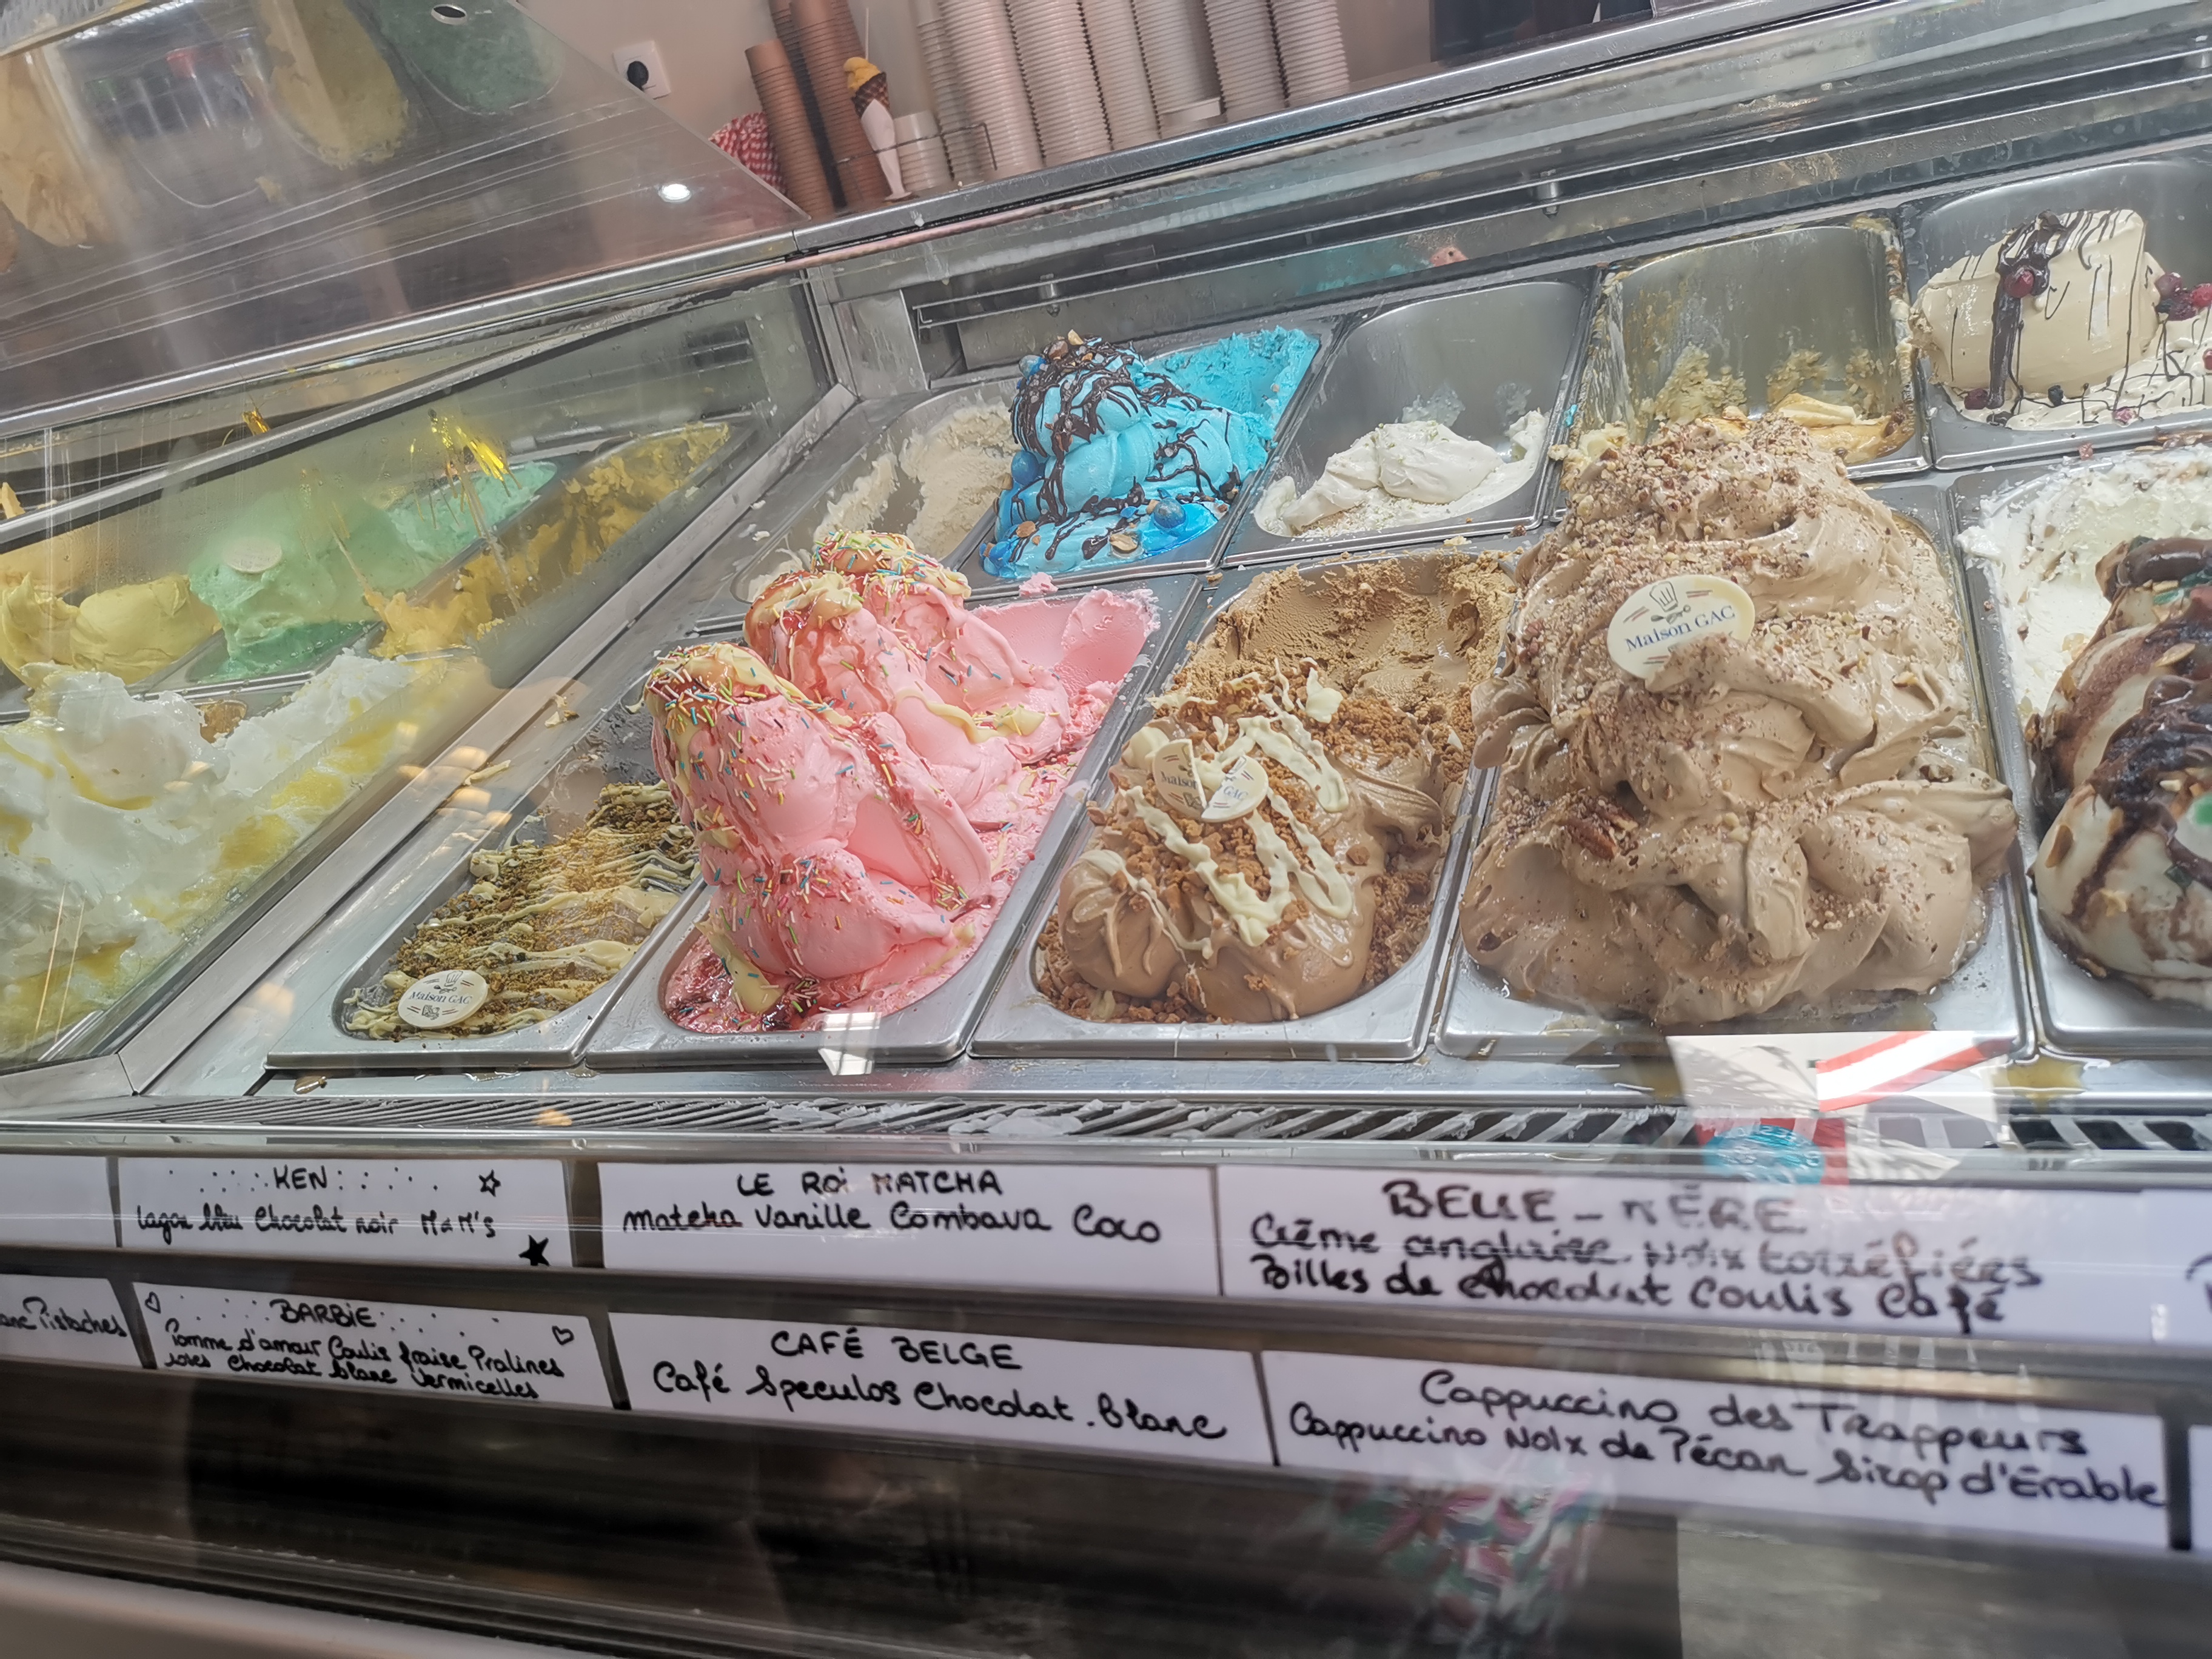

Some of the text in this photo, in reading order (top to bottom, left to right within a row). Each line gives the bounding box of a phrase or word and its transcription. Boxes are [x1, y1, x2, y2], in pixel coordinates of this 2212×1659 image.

[1694, 605, 1736, 629] GAC
[408, 991, 473, 1005] Maison GAC
[273, 1165, 329, 1190] KEN
[736, 1171, 776, 1197] LE
[871, 1168, 1004, 1196] MATCHA
[356, 1210, 399, 1235] noir
[889, 1200, 1053, 1233] Combava
[1072, 1202, 1162, 1244] Coco
[1250, 1253, 1370, 1294] Billes
[1384, 1260, 1443, 1296] de
[1877, 1282, 2005, 1335] Café
[164, 1318, 233, 1352] Pomme
[237, 1328, 322, 1357] d'amour
[398, 1341, 468, 1373] fraise
[468, 1344, 565, 1378] Pralines
[769, 1325, 1024, 1370] CAFÉ BELGE
[652, 1361, 732, 1396] Café
[745, 1365, 902, 1413] Speculos
[1419, 1369, 2090, 1464] Cappuccino des Trappeurs
[1289, 1401, 1487, 1453] Cappuccino
[1504, 1423, 1588, 1458] Noix
[1600, 1429, 1655, 1461] de
[1658, 1425, 1808, 1478] Pécan
